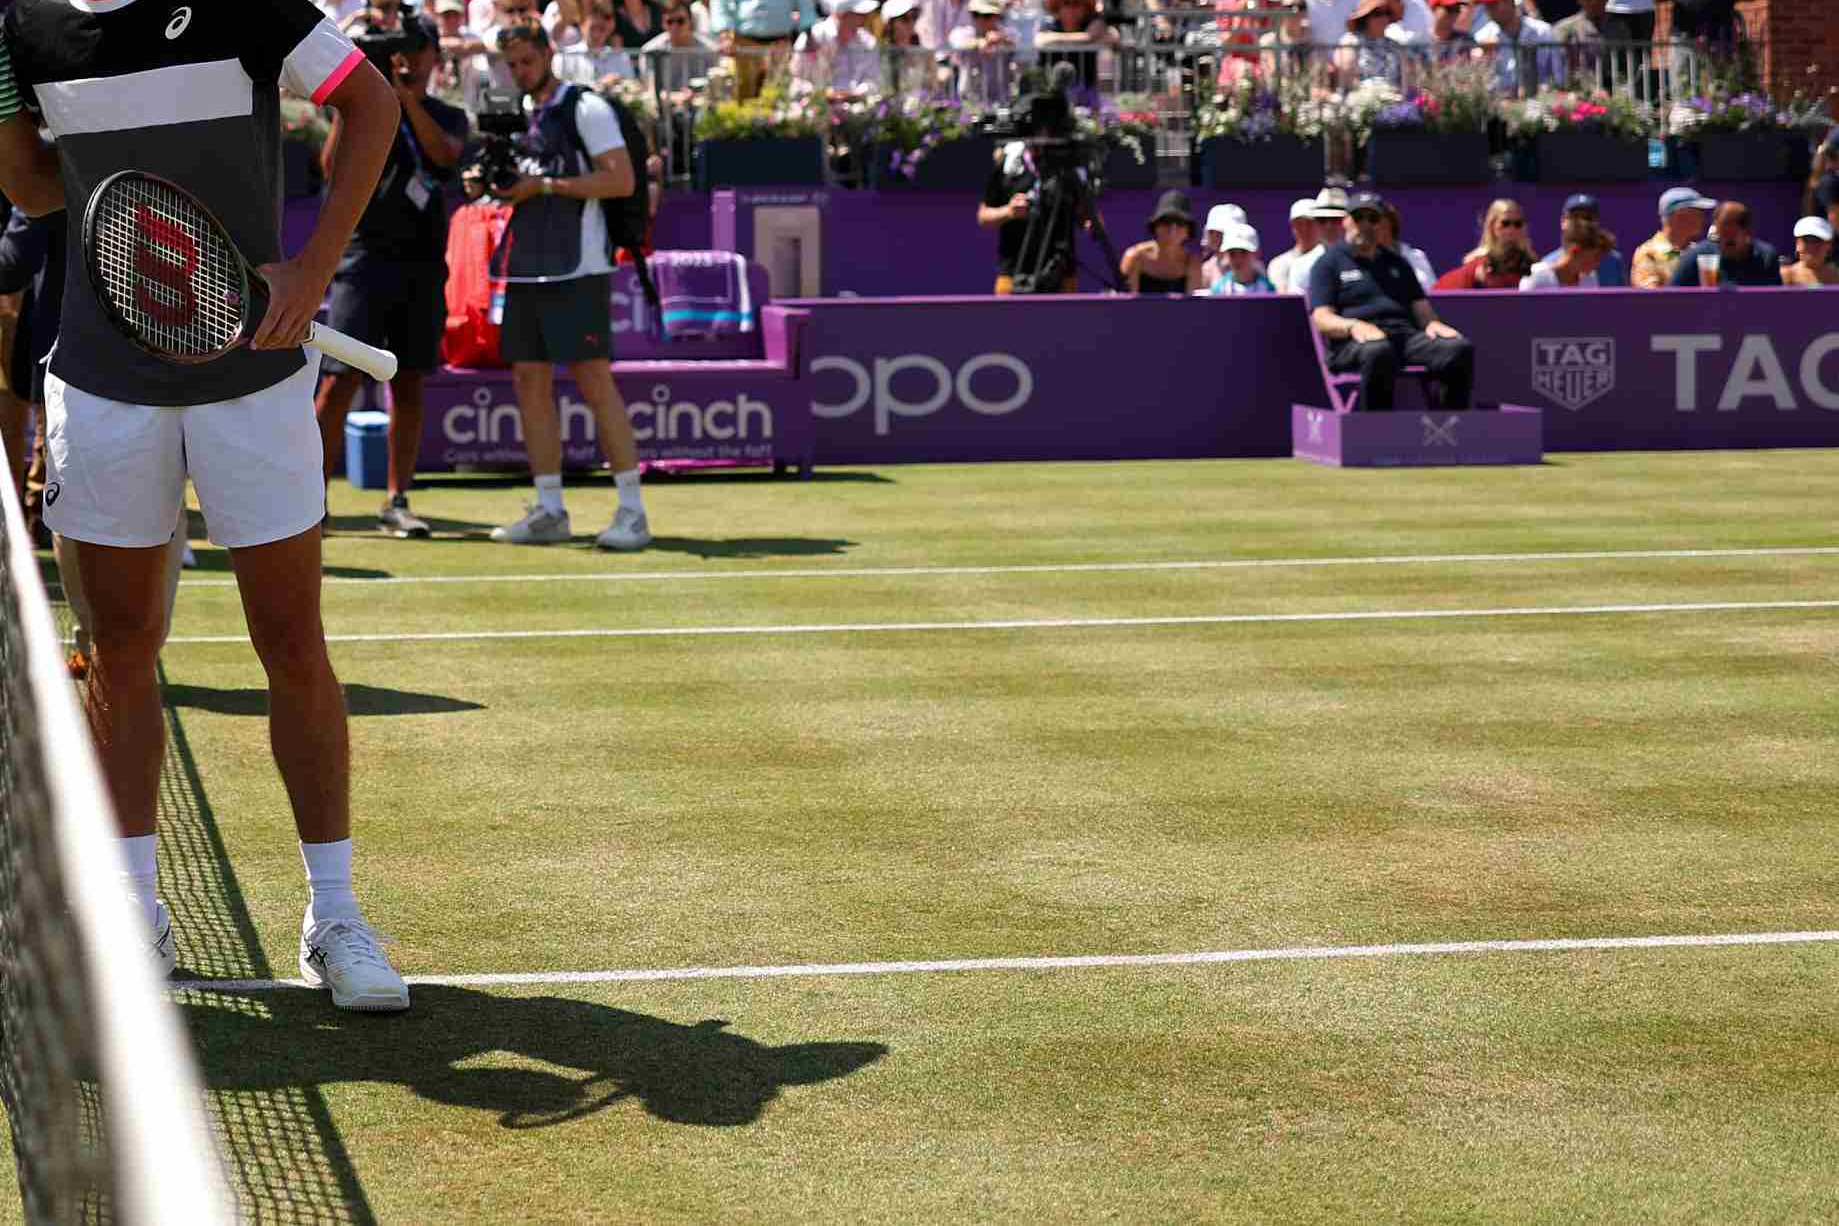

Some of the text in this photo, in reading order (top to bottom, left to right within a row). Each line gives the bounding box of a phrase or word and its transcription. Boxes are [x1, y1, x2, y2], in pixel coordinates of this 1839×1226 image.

[1540, 344, 1607, 364] TAG
[1537, 370, 1610, 399] HEUER
[442, 387, 596, 443] cinh
[627, 384, 773, 440] cinch
